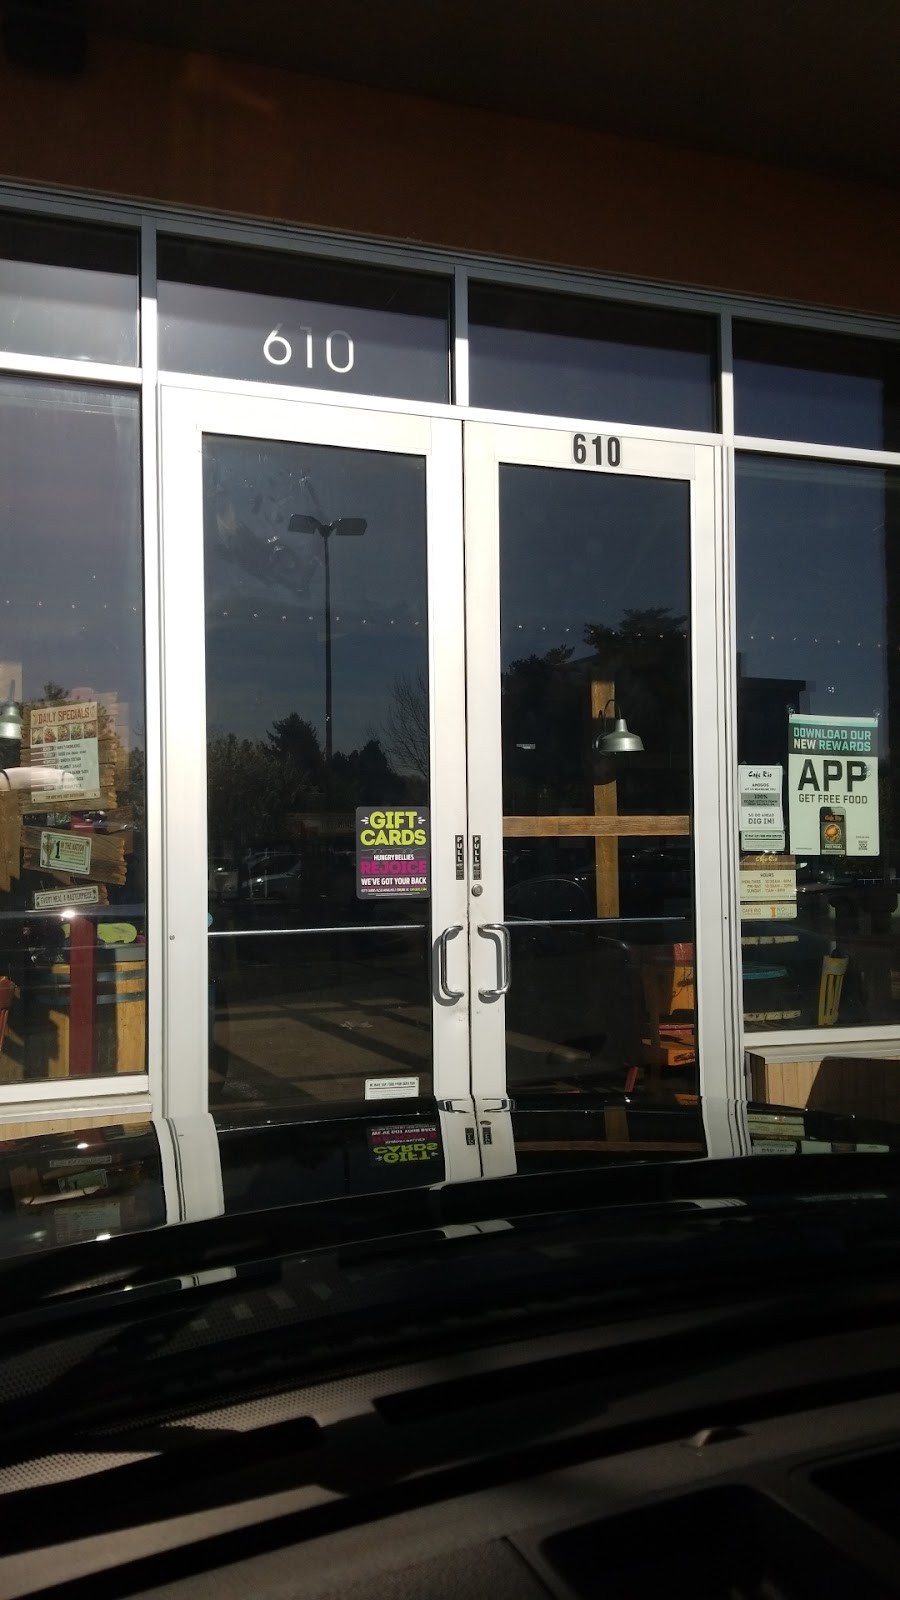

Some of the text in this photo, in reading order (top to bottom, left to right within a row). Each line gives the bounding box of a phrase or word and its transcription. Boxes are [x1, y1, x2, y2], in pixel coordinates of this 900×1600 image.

[263, 323, 354, 373] 610
[573, 433, 621, 467] 610
[38, 707, 90, 725] DAILY SPECIALS
[793, 727, 872, 741] DOWNLOAD OUR
[793, 739, 871, 752] NEW REWARDS
[797, 759, 867, 793] APP
[798, 794, 868, 805] GET FREE FOOD
[369, 811, 418, 829] GIFT
[360, 829, 427, 846] CARDS
[361, 860, 428, 875] REJOICE
[361, 876, 427, 886] WE'VE GOT YOUR BACK
